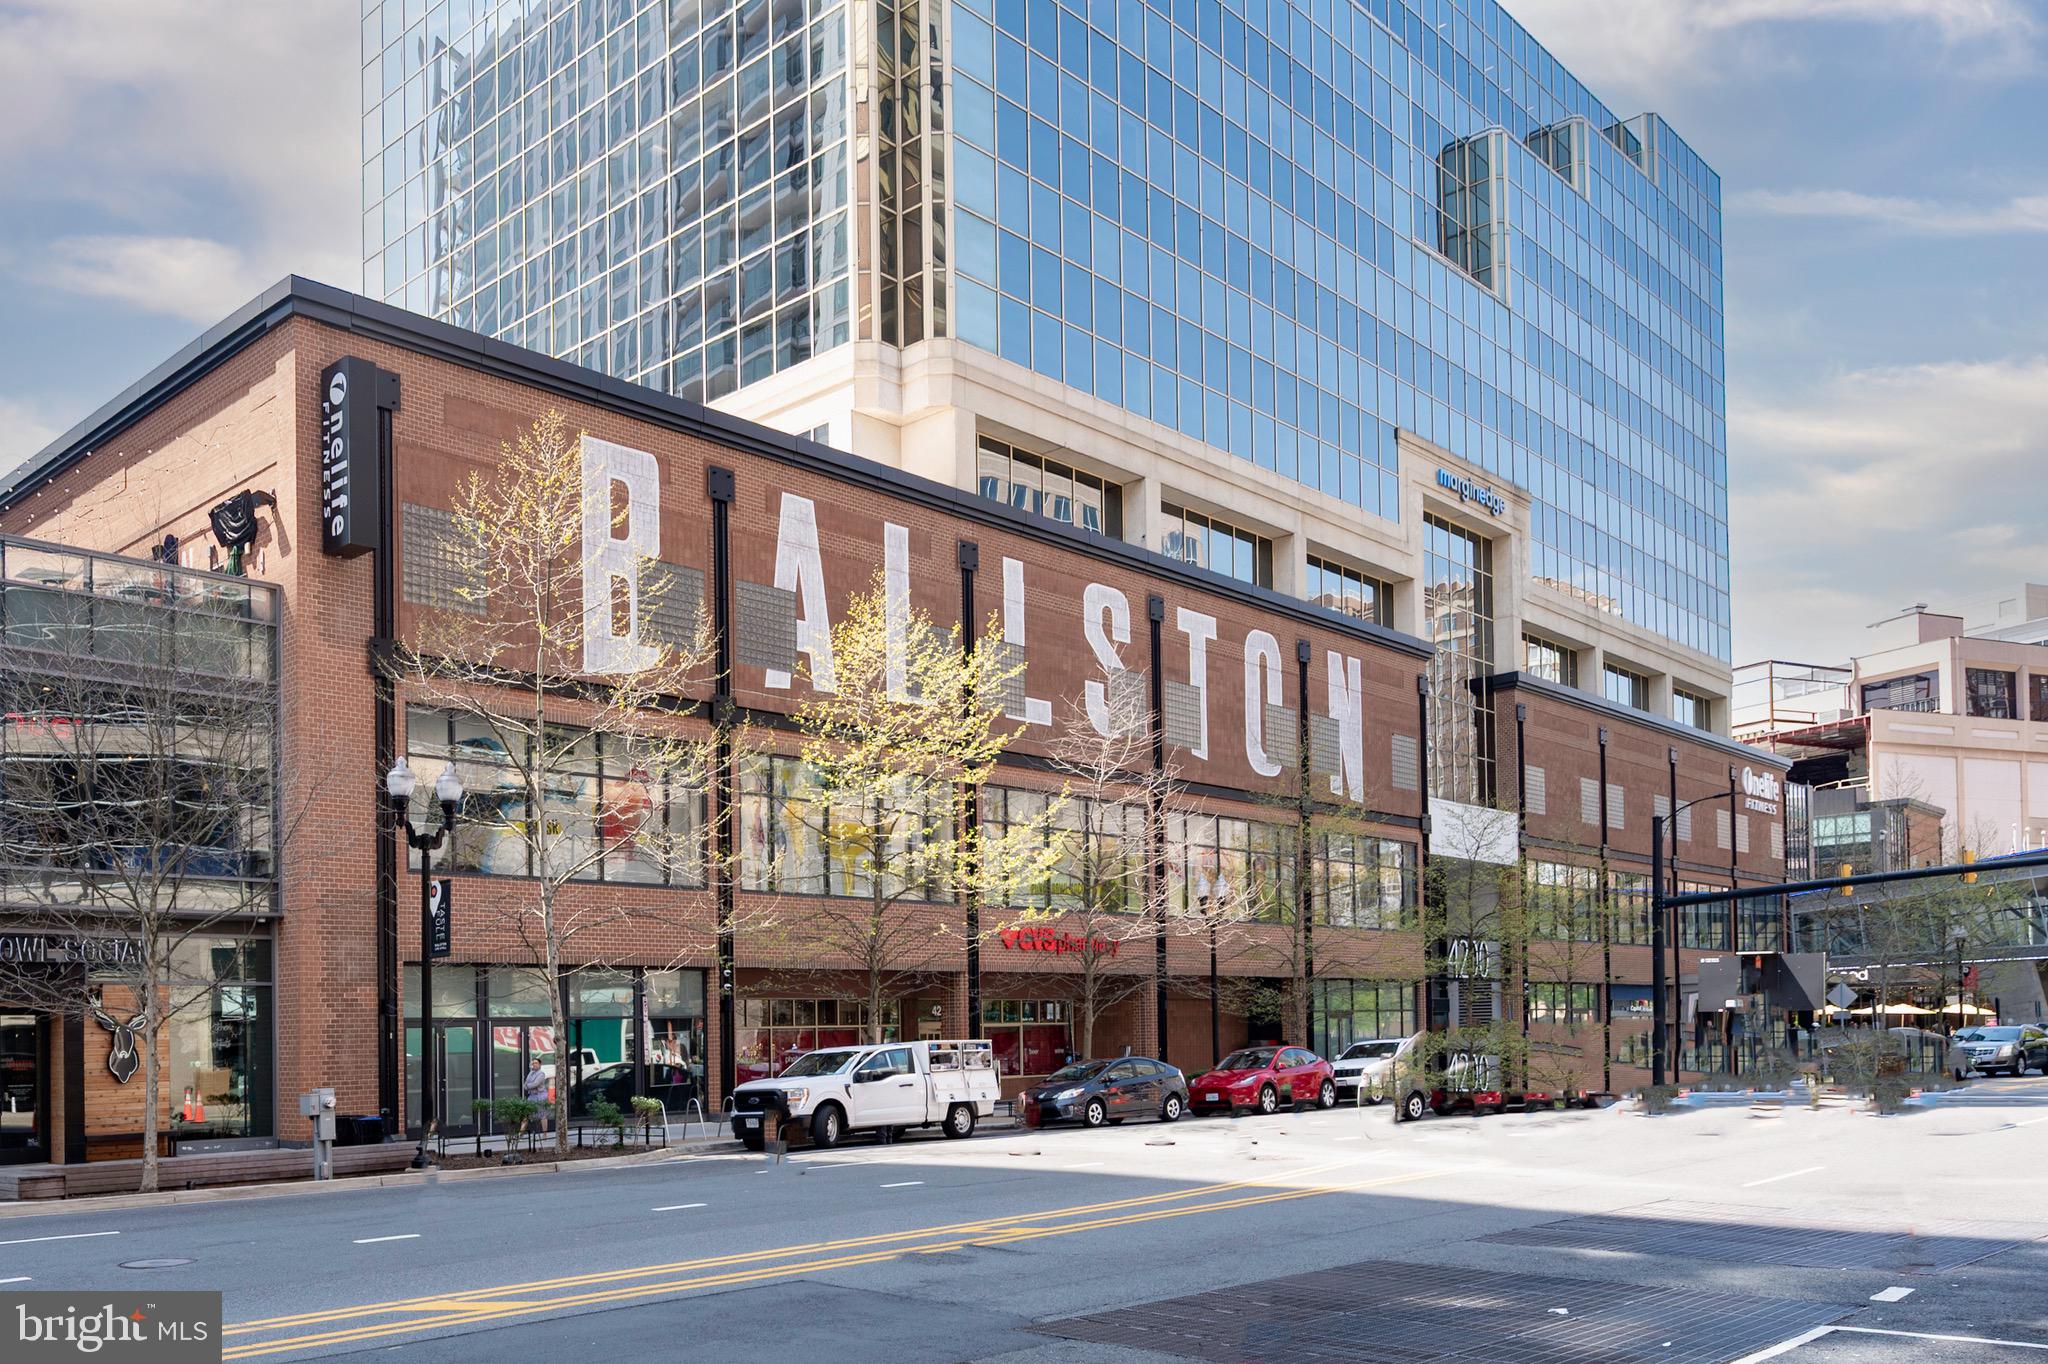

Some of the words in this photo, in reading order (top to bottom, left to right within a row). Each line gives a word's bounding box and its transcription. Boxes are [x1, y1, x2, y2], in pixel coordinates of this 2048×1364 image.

[322, 402, 331, 519] FITNESS
[581, 434, 1364, 803] BALLSTON
[1741, 766, 1779, 802] Onelife
[1744, 798, 1777, 815] FITNESS
[1019, 926, 1057, 951] CVS
